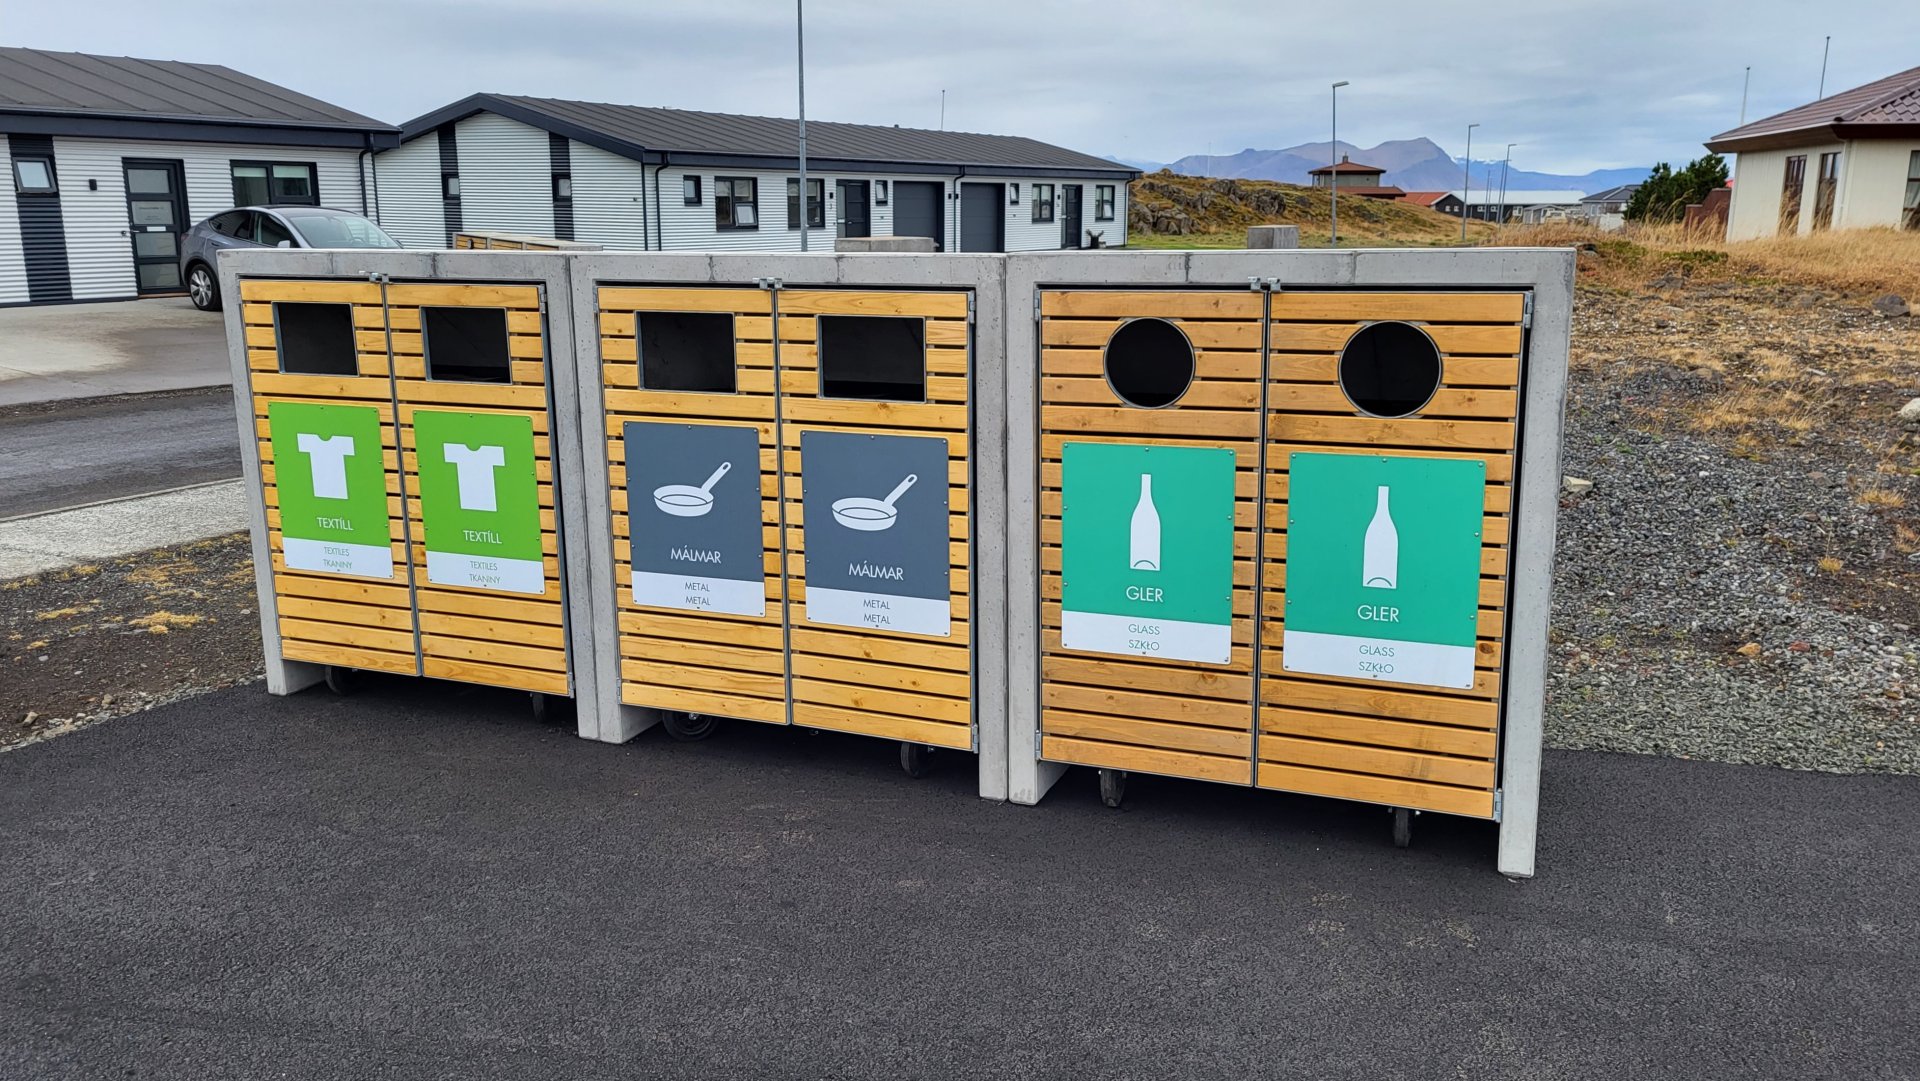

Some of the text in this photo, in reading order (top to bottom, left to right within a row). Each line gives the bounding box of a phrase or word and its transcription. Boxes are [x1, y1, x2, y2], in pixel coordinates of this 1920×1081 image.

[317, 517, 354, 531] TEXTÍLL
[463, 530, 502, 544] TEXTÍLL
[324, 546, 350, 557] TEXTILES
[670, 545, 722, 564] MÁLMAR
[323, 558, 352, 569] TKANINY
[469, 560, 498, 571] TEXTILES
[848, 560, 904, 581] MÁLMAR
[469, 573, 501, 584] TKANINY
[684, 581, 710, 593] METAL
[1125, 585, 1164, 603] GLER
[685, 595, 711, 606] METAL
[863, 599, 891, 611] METAL
[863, 613, 891, 625] METAL
[1357, 604, 1400, 623] GLER
[1128, 623, 1161, 636] GLASS
[1128, 639, 1160, 651] SZKŁO
[1359, 644, 1396, 657] GLASS
[1358, 660, 1395, 674] SZKŁO
